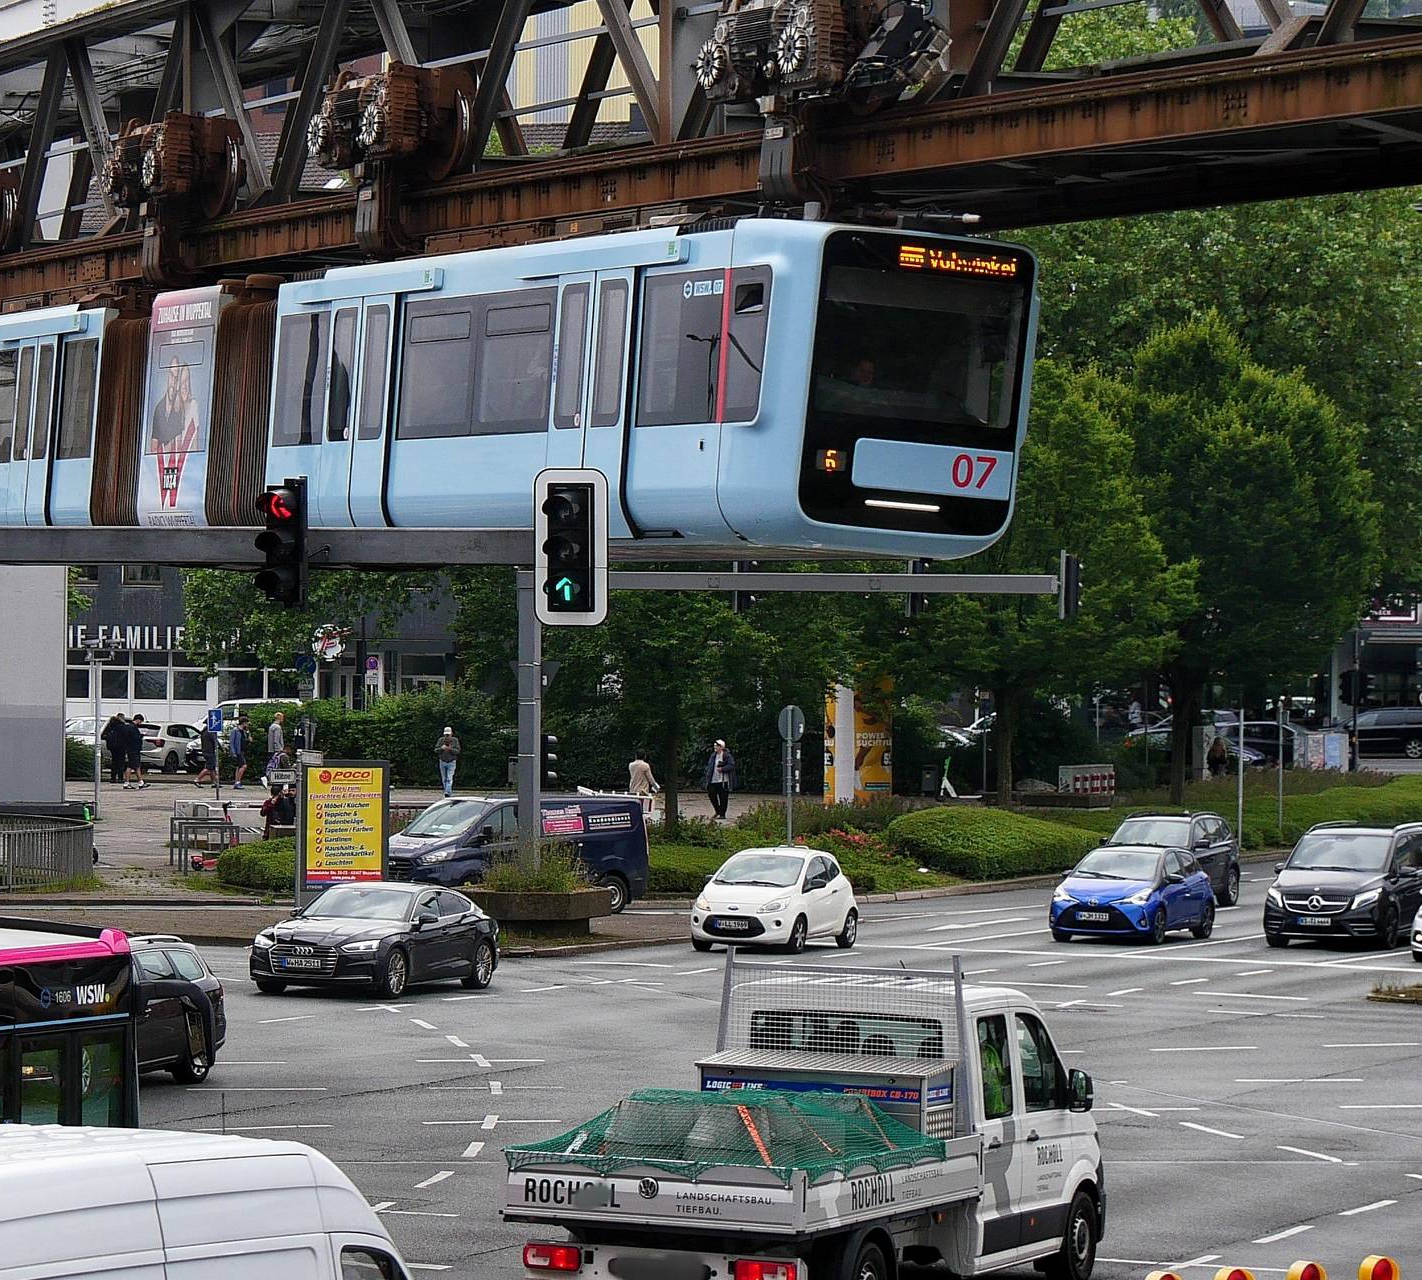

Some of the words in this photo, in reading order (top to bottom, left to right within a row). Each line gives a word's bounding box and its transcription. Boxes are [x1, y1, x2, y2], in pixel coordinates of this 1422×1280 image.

[186, 301, 212, 320] WUPPERTAL
[951, 453, 998, 490] 07
[98, 625, 186, 650] FAMILIE
[333, 771, 371, 779] POCO
[54, 990, 72, 1004] 1606
[1036, 1143, 1064, 1166] ROCHOLL
[523, 1177, 621, 1209] ROCHL
[676, 1191, 775, 1206] LANDSCHAFTSBAU.
[850, 1173, 896, 1211] ROCHOLL
[676, 1205, 723, 1216] TIEFBAU.
